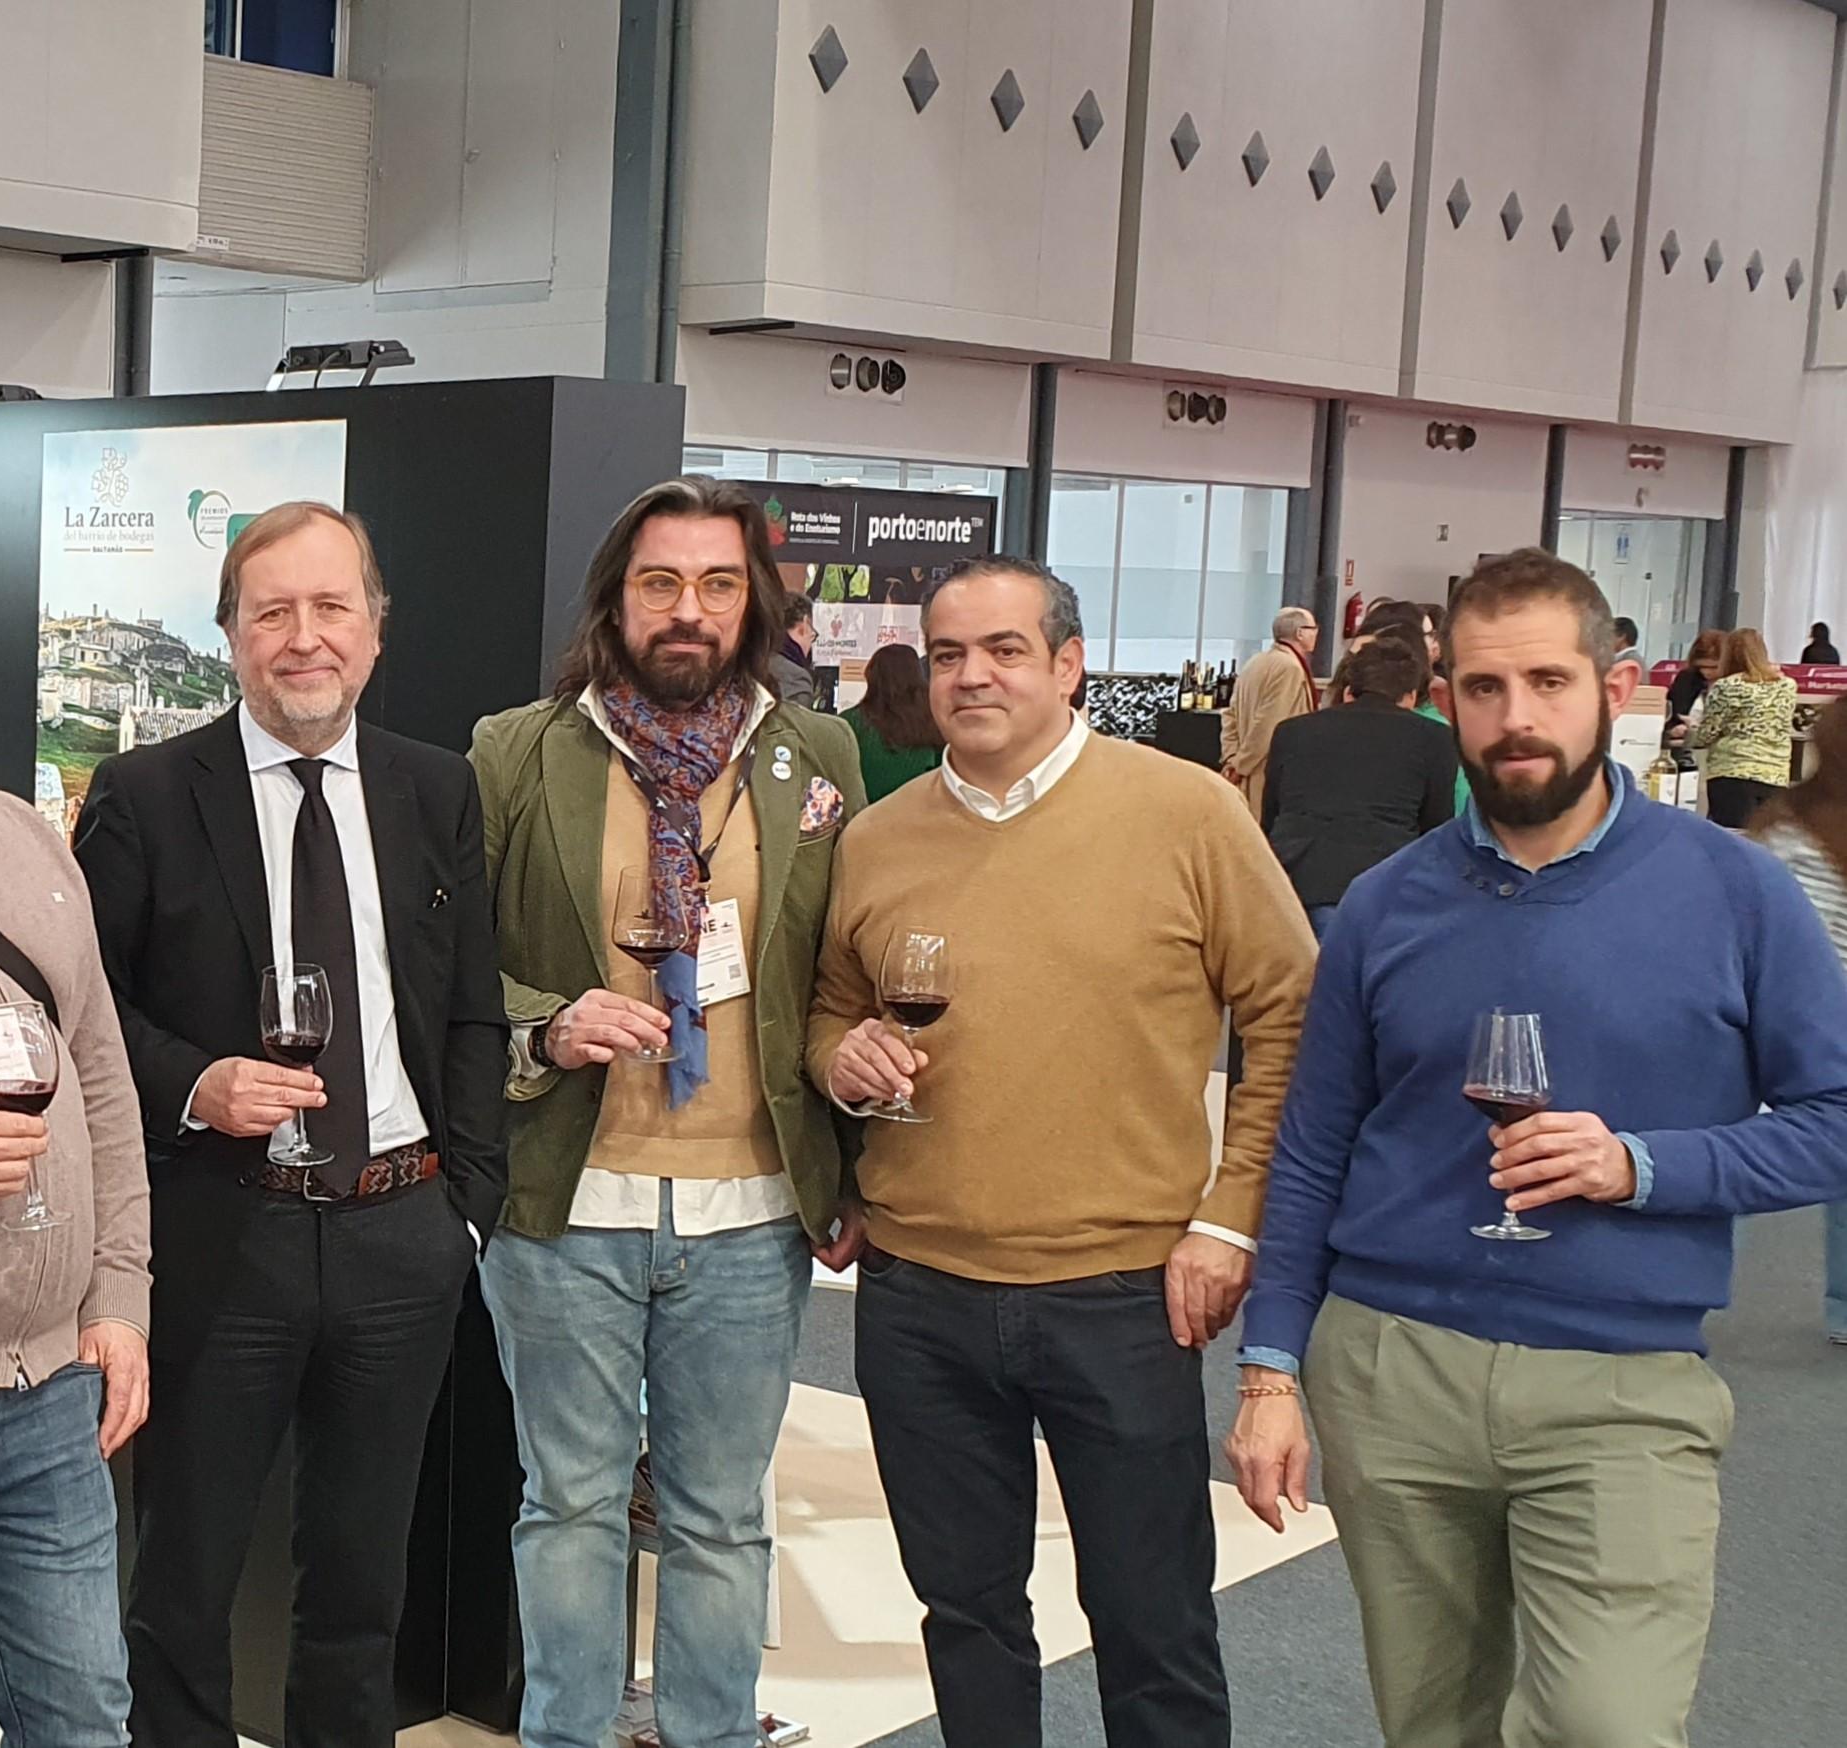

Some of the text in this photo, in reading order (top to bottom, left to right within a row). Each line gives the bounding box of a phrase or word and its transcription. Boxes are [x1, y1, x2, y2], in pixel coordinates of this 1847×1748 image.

[65, 506, 154, 528] La Zarcera
[63, 530, 154, 544] del barrio de bodegas
